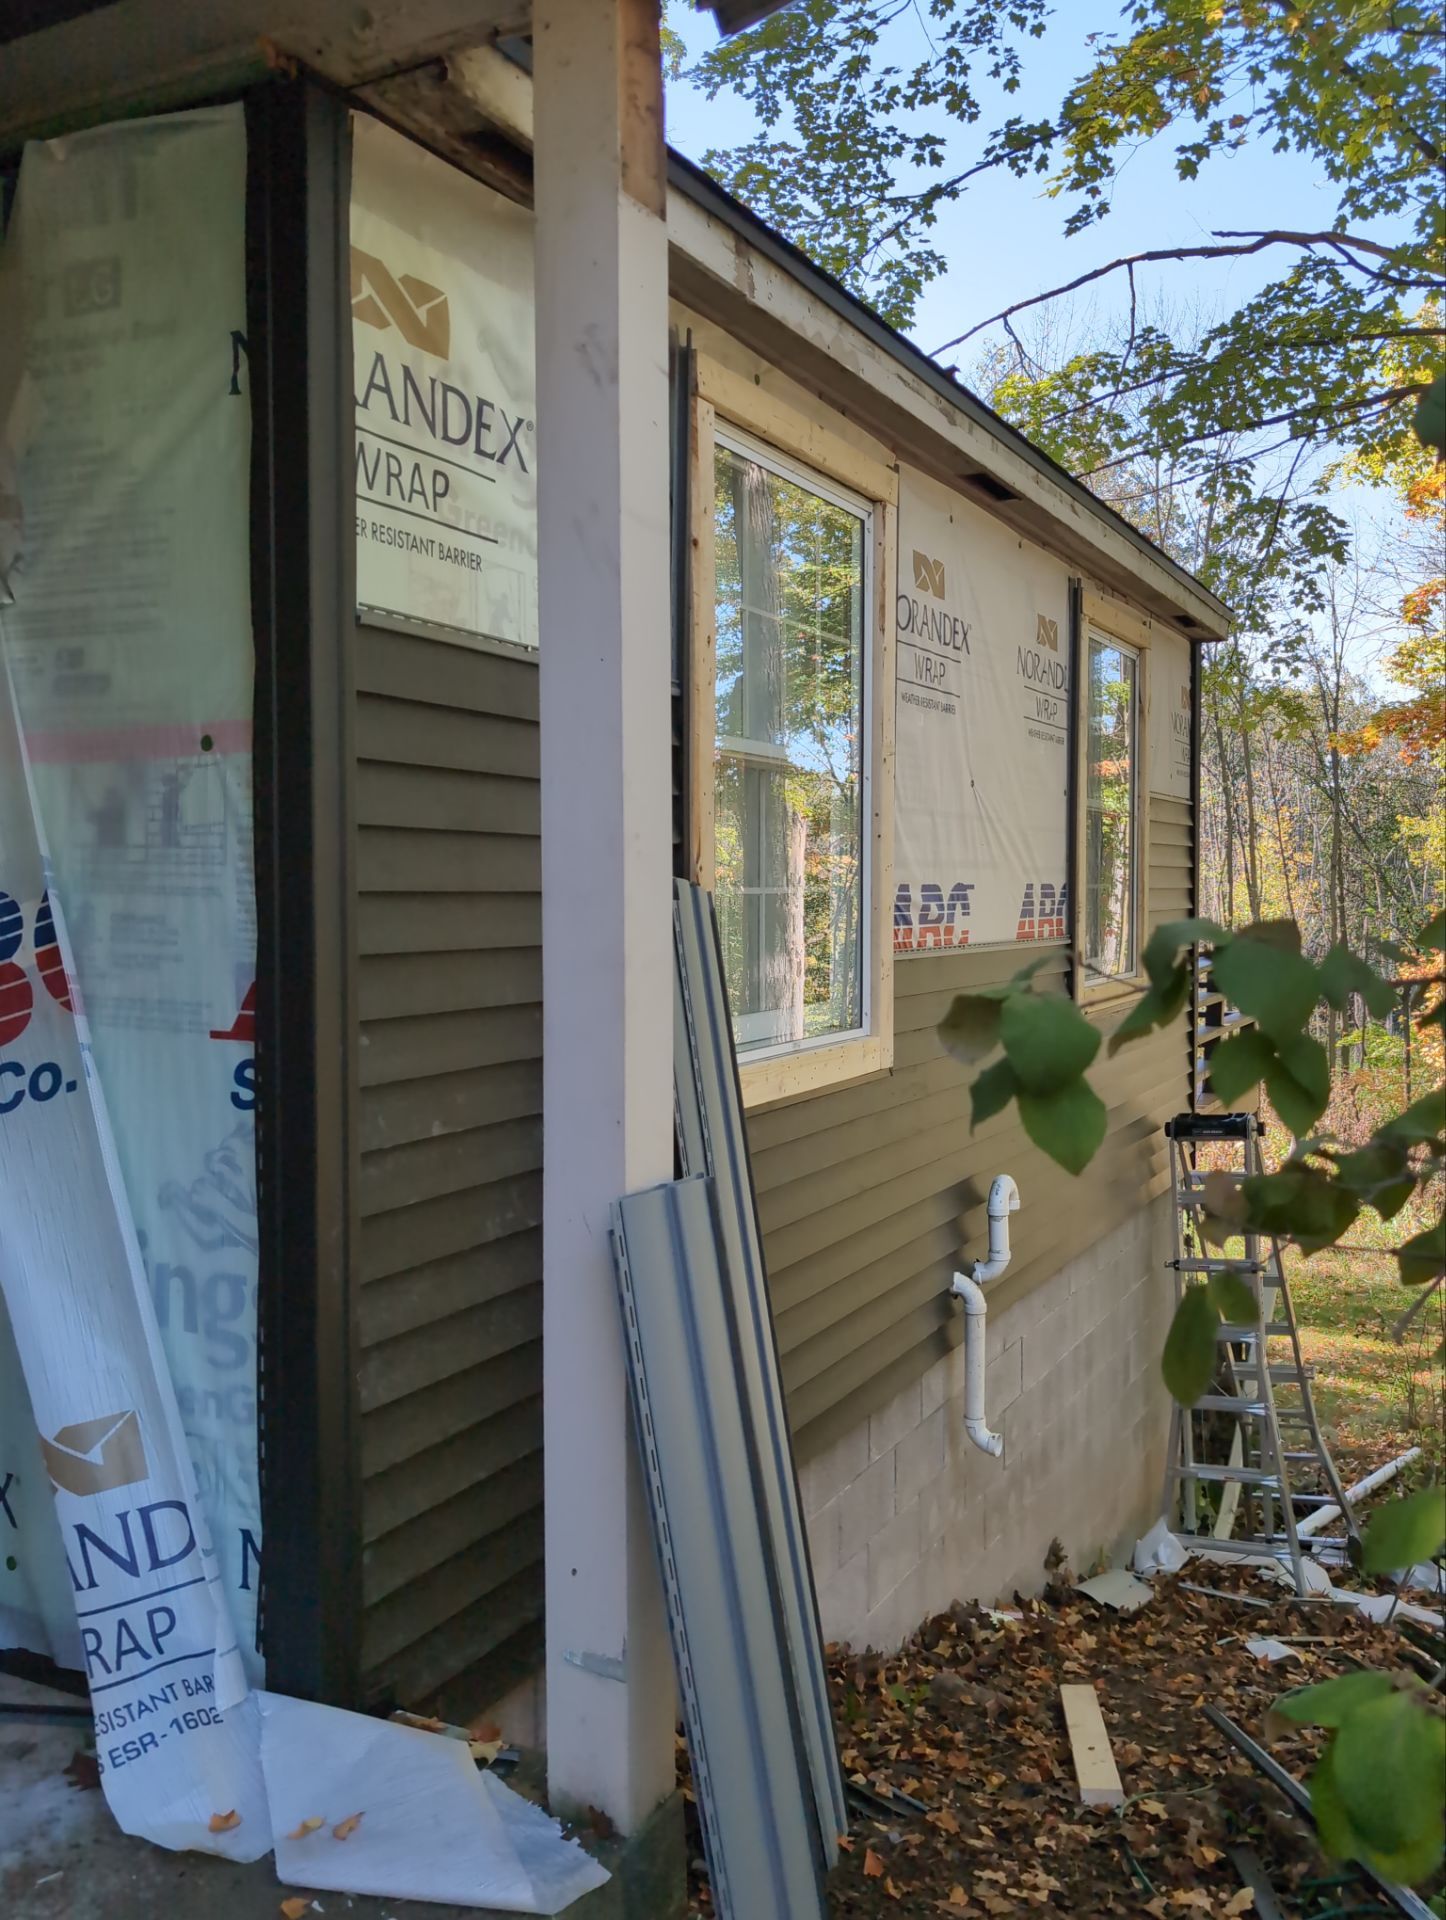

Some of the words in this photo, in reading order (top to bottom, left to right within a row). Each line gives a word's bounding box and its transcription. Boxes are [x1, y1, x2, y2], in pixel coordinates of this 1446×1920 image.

[371, 521, 435, 557] RESISTANT
[438, 542, 482, 572] BARRIER
[914, 652, 946, 686] WRAP
[1036, 696, 1057, 721] WRAP
[181, 1674, 214, 1697] BAR
